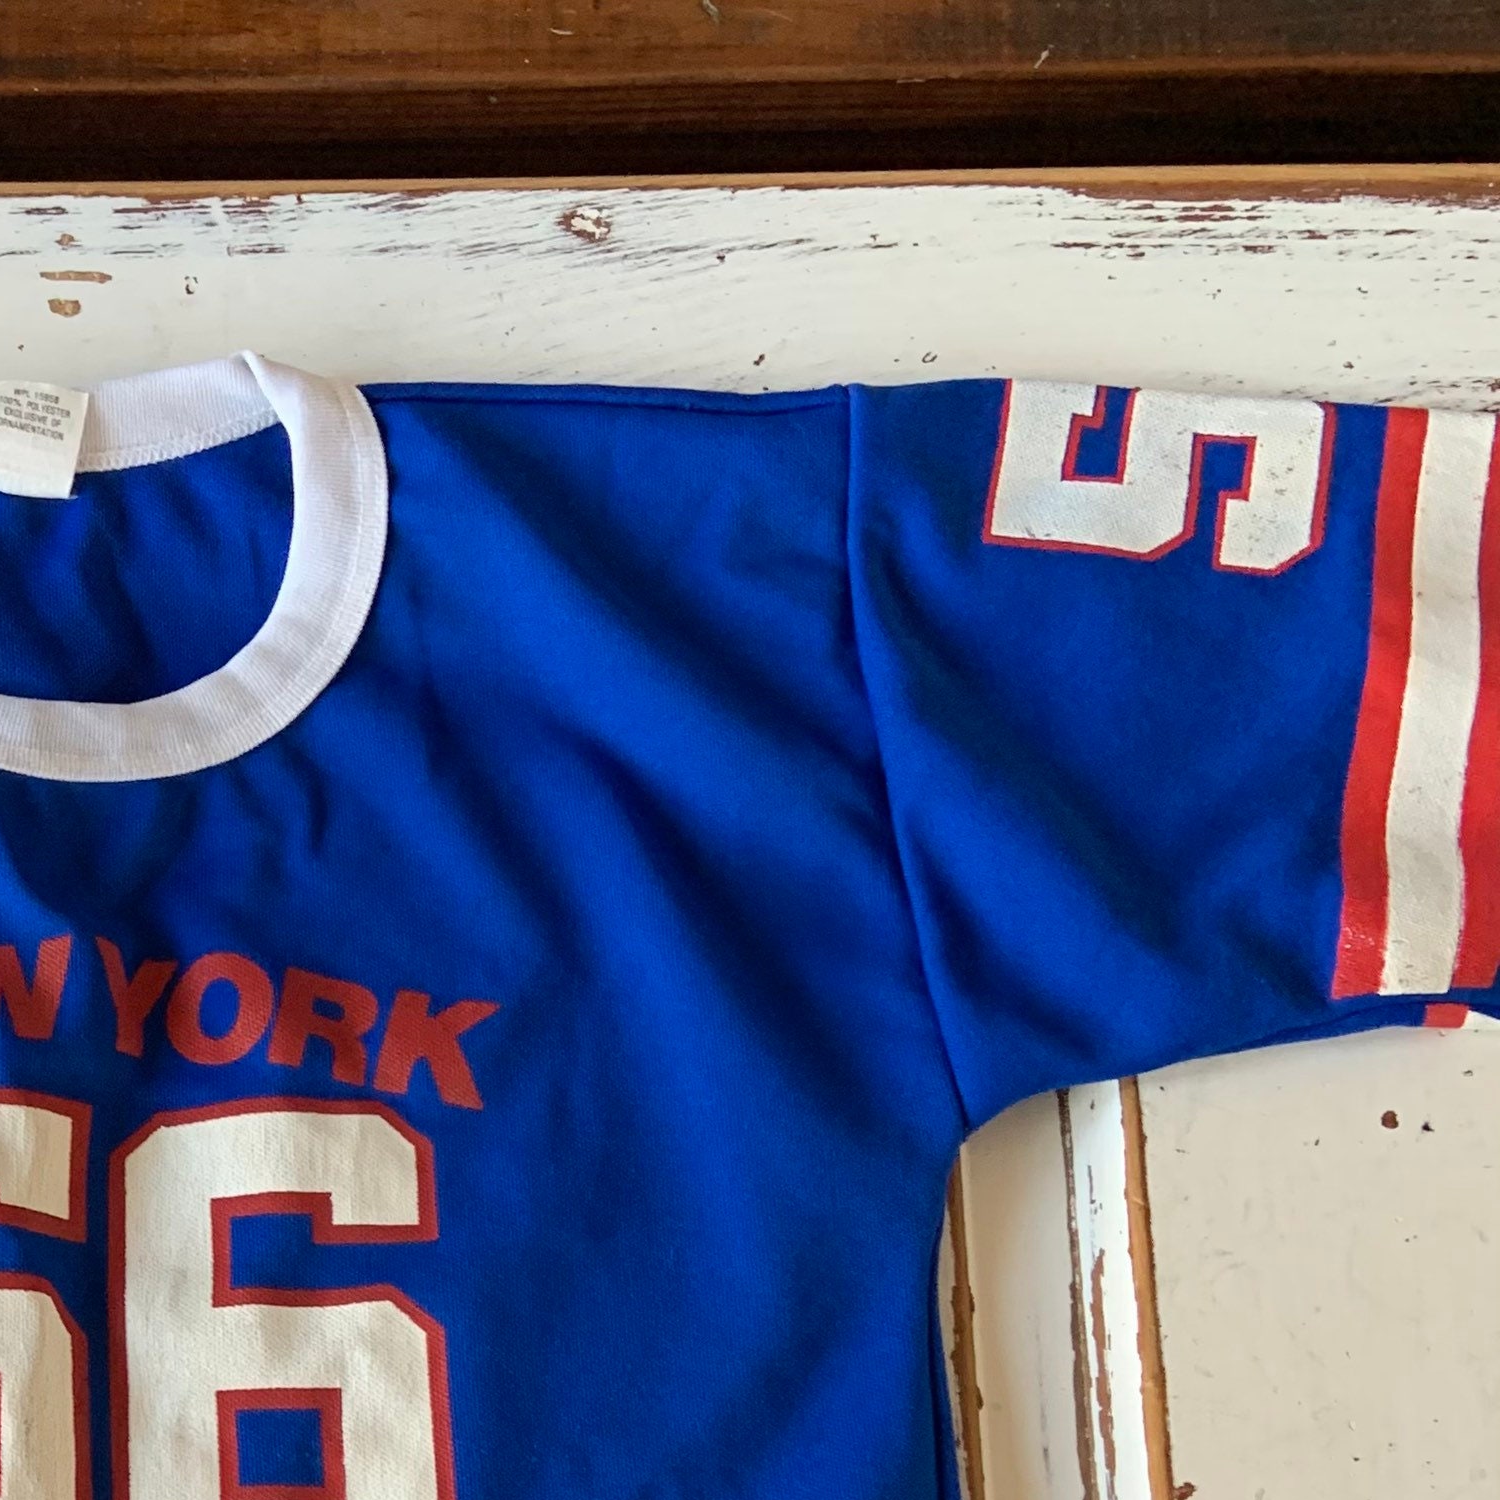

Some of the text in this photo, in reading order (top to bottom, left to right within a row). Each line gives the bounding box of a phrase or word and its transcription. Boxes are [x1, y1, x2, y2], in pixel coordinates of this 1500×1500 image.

[0, 395, 71, 418] 100% POLYESTER
[3, 406, 62, 428] EXCLUSIVE OF
[93, 935, 501, 1111] YORK
